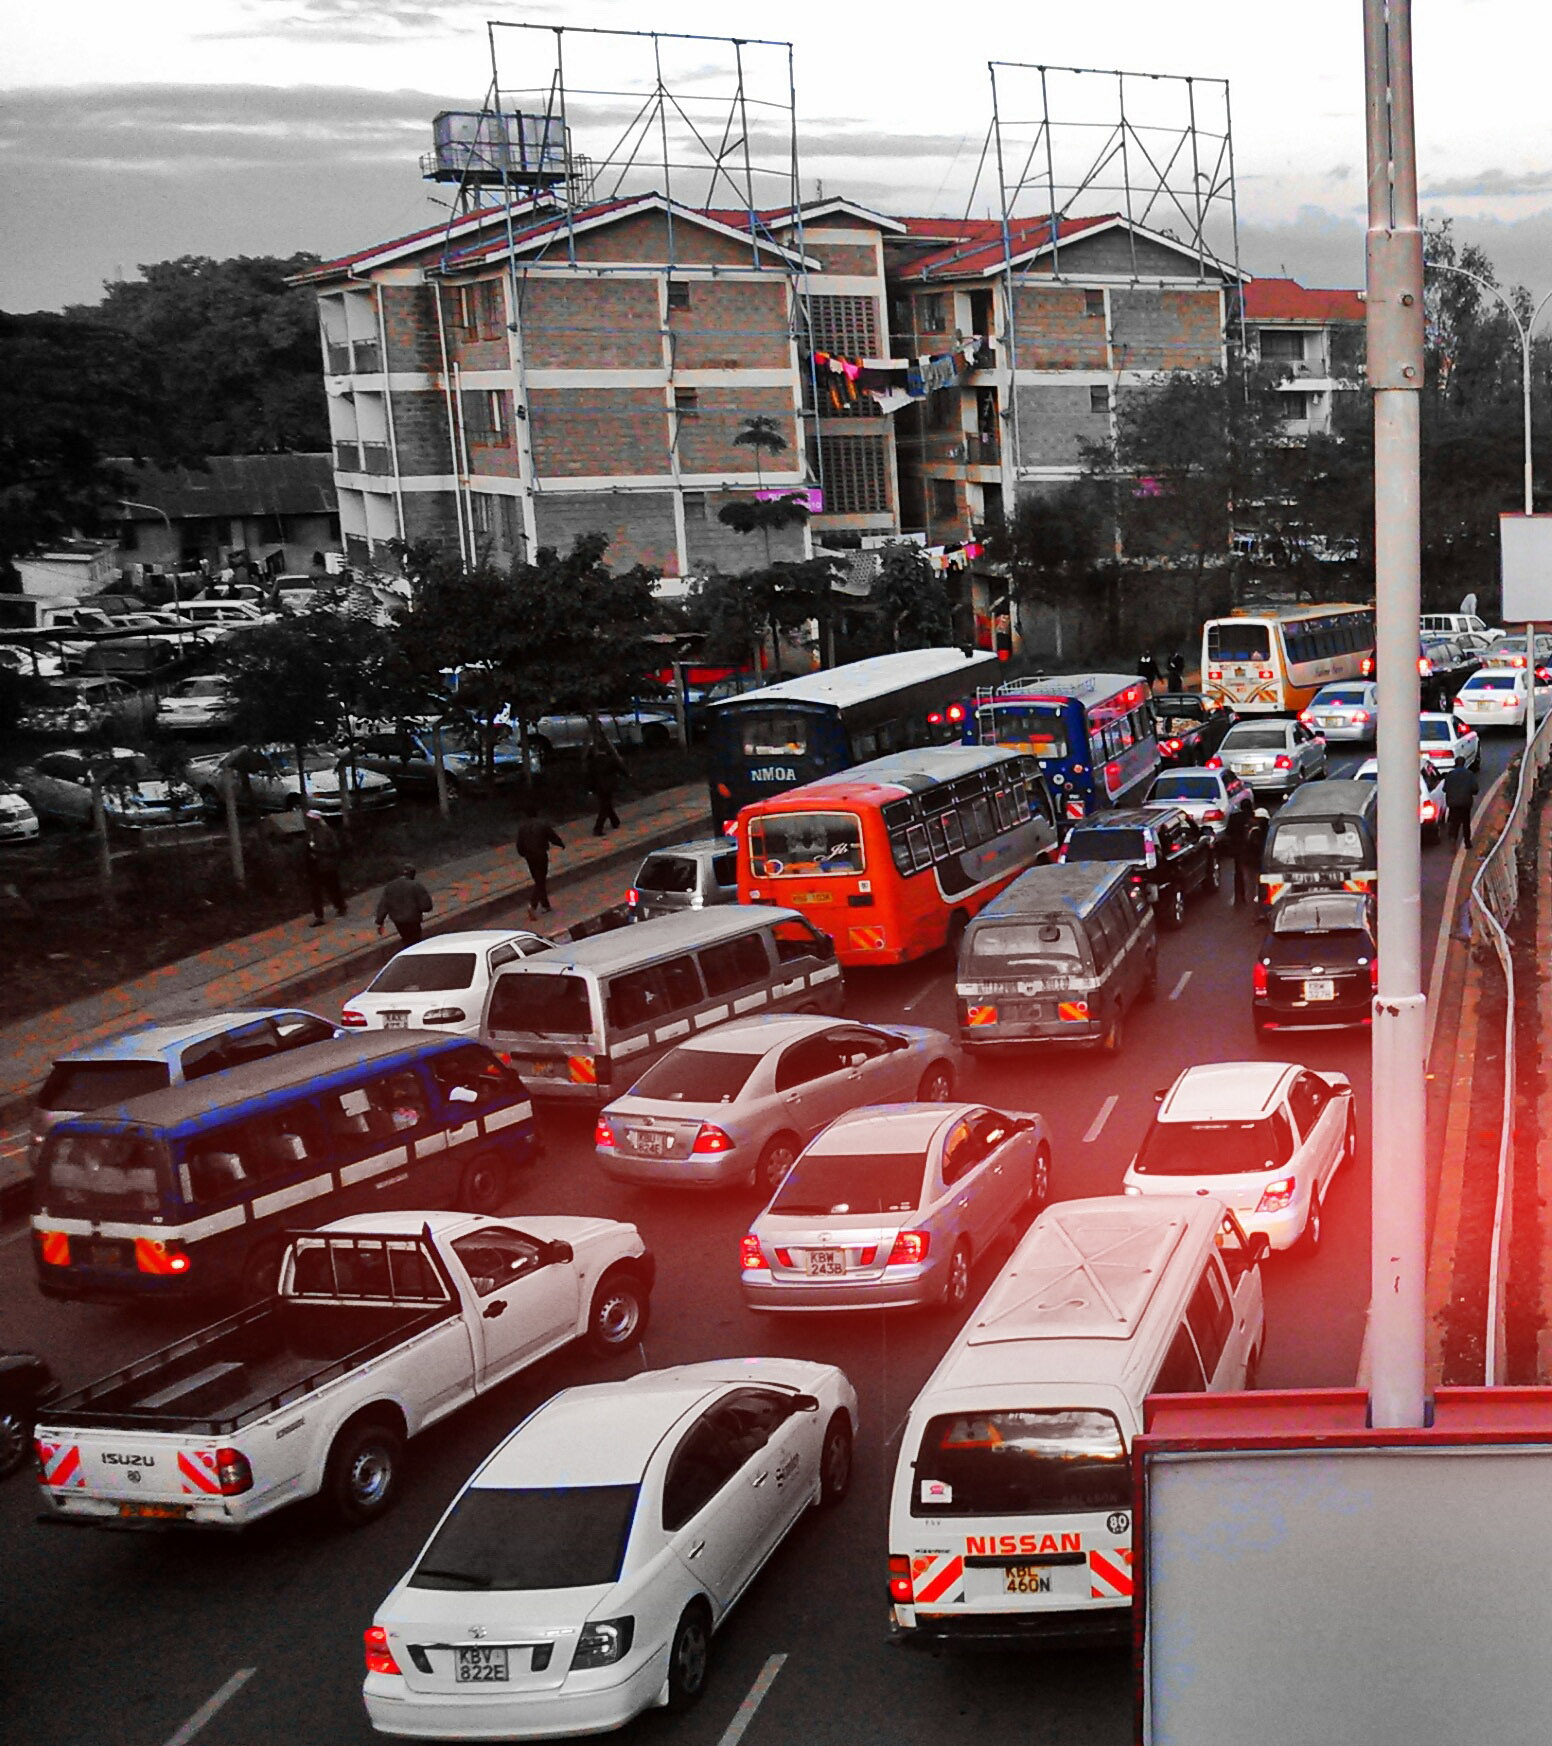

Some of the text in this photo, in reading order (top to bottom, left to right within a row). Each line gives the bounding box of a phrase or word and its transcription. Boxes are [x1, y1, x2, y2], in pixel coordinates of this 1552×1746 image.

[750, 766, 797, 782] NMOA
[810, 1251, 834, 1264] KBW
[811, 1263, 843, 1275] 243B
[101, 1452, 155, 1467] ISUZU
[1109, 1513, 1128, 1528] 80
[966, 1533, 1081, 1554] NISSAN
[1006, 1577, 1051, 1593] 460N
[459, 1650, 491, 1664] KBV
[460, 1664, 505, 1681] 822E
